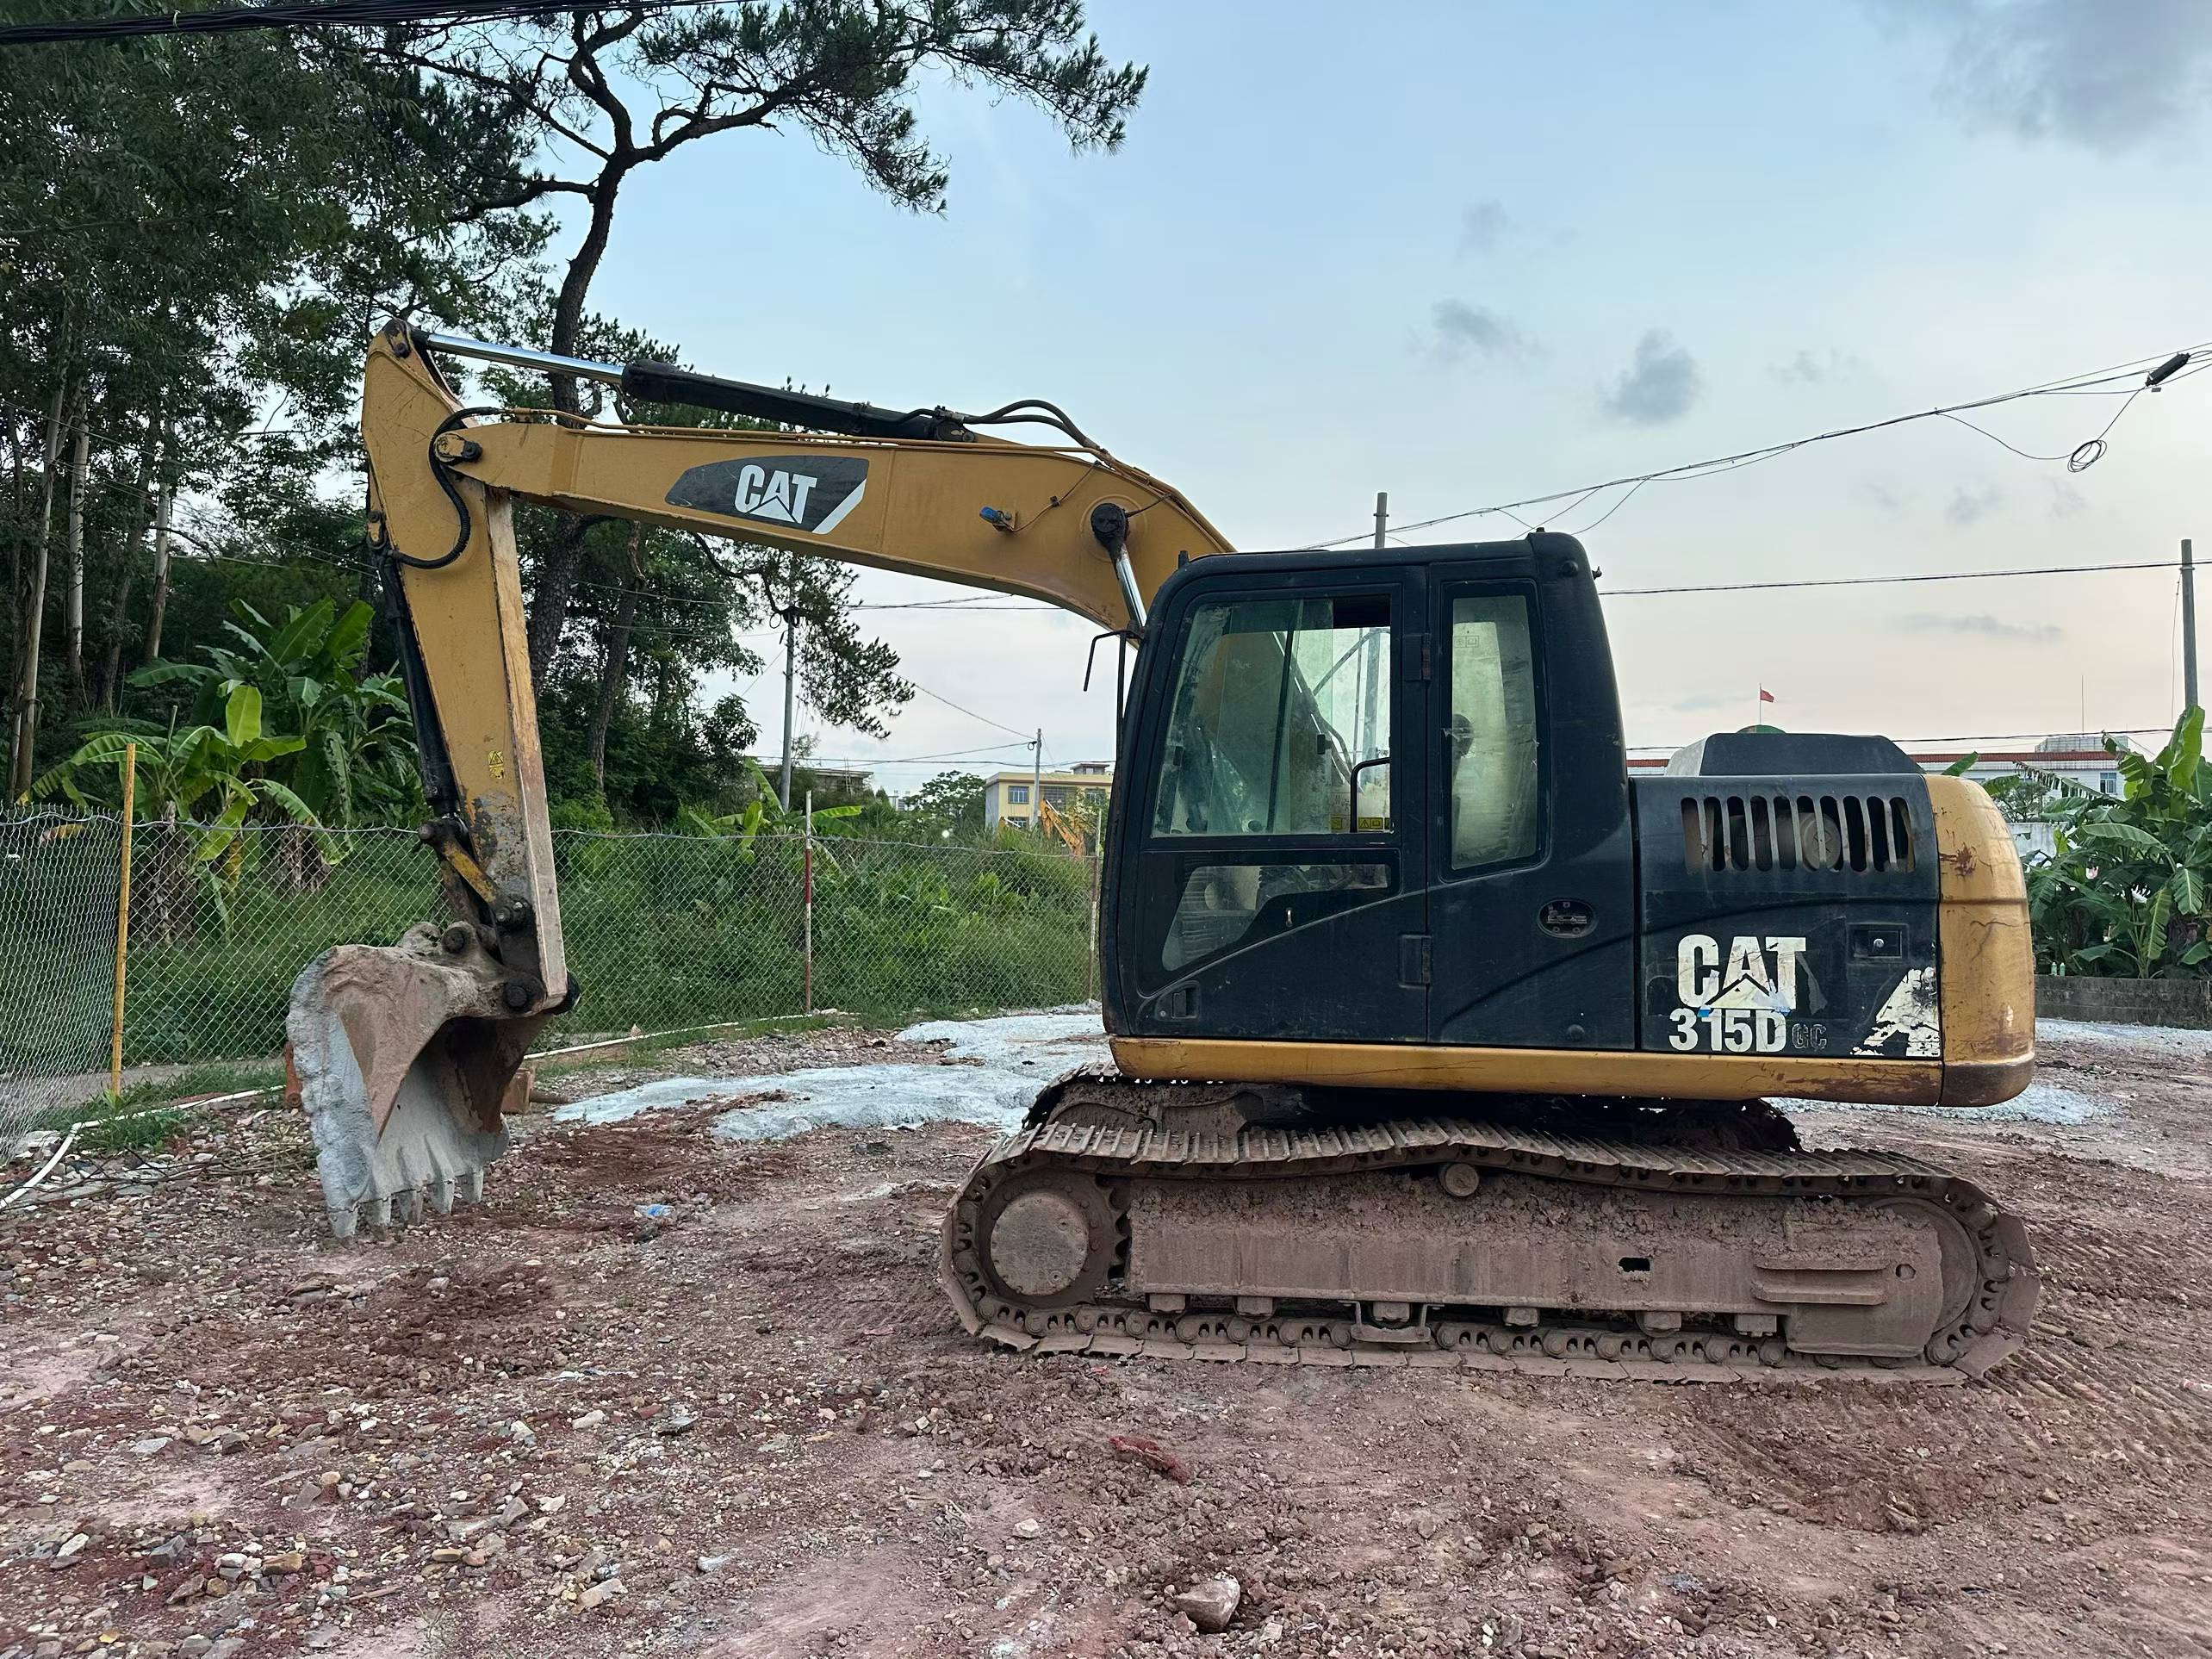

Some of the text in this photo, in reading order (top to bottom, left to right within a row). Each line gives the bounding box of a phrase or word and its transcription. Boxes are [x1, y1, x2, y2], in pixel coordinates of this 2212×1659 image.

[735, 464, 817, 524] CAT
[1678, 934, 1806, 1010] CAT
[1669, 1008, 1786, 1052] 315D
